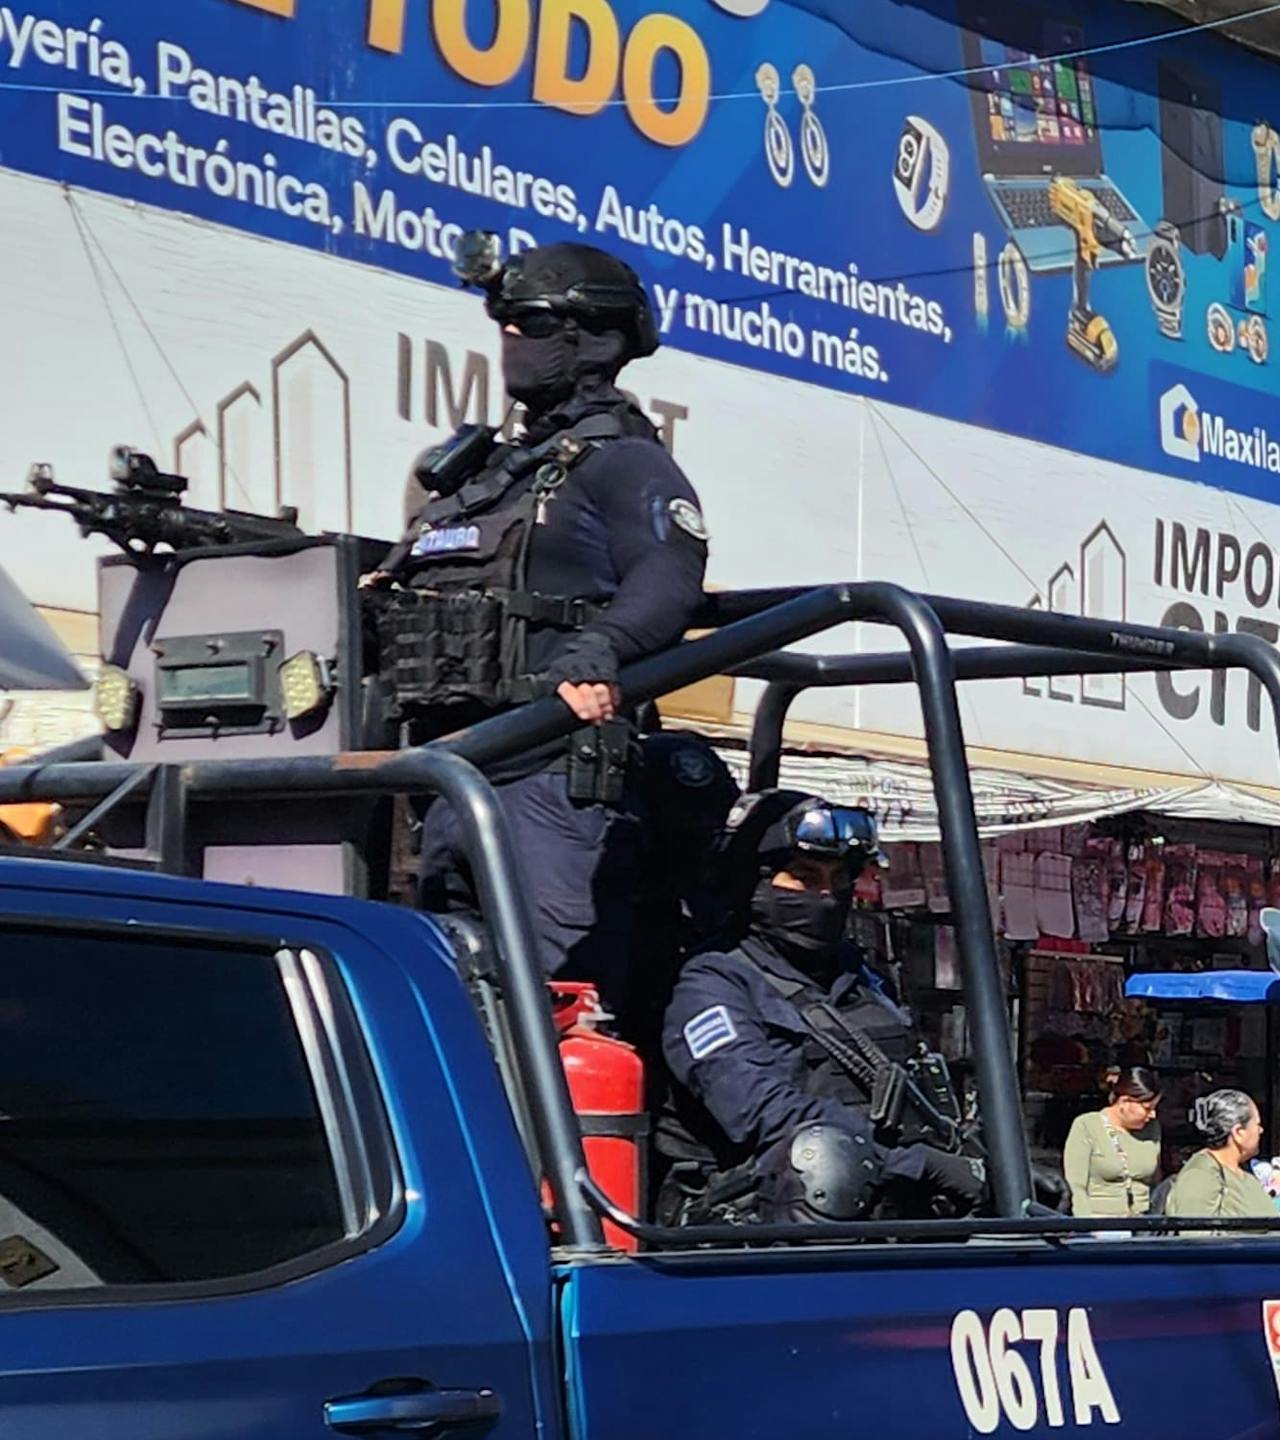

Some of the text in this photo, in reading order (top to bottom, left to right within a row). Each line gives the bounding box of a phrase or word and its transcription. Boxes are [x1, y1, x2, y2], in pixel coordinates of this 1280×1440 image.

[0, 8, 952, 343] yería, Pantallas, Celulares, Autos, Herramientas,
[57, 93, 343, 234] Electrónica,
[396, 332, 689, 458] IMT
[653, 284, 889, 382] y mucho más.
[950, 1308, 1120, 1434] 067A
